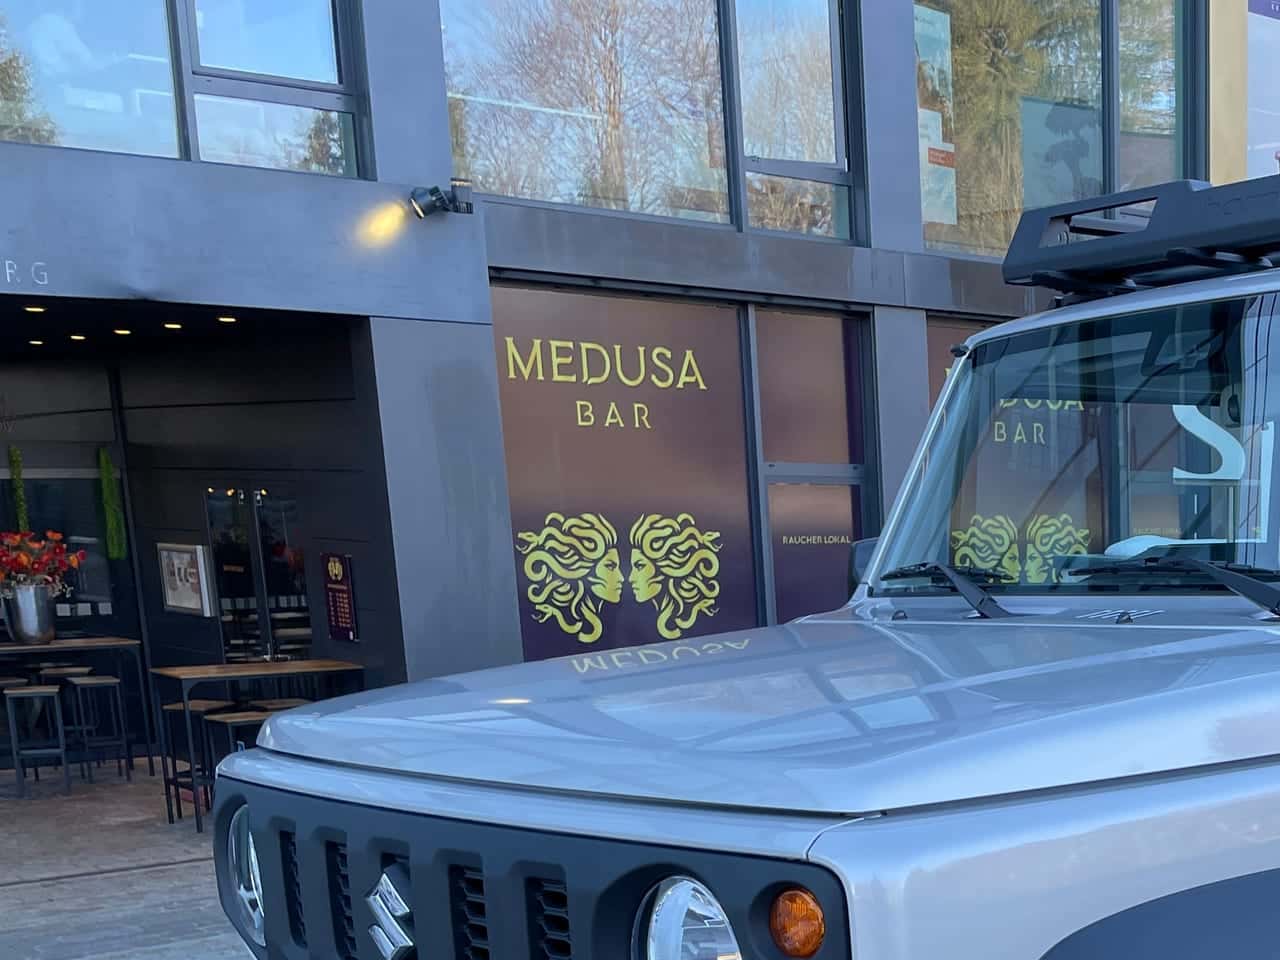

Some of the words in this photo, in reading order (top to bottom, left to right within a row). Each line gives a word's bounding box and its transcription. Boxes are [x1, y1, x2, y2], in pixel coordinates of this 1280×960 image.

[504, 336, 707, 390] MEDUSA
[575, 400, 651, 429] BAR
[994, 421, 1046, 445] BAR
